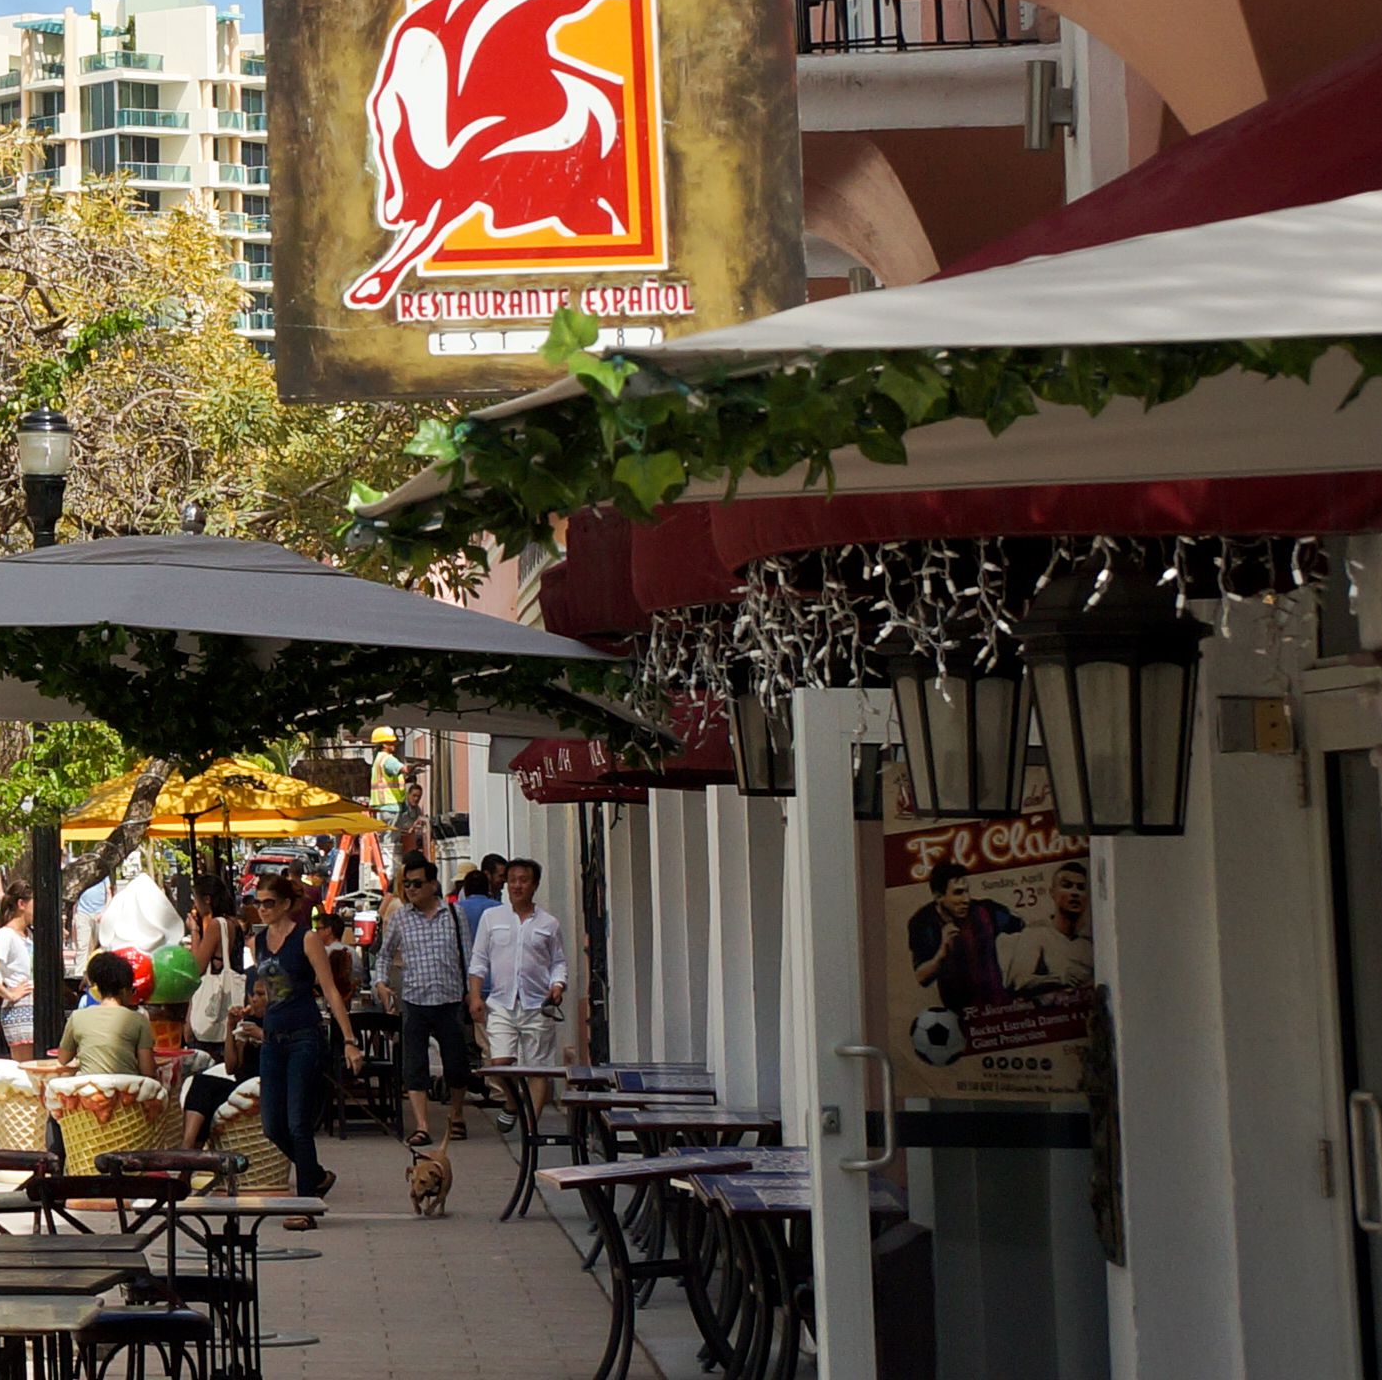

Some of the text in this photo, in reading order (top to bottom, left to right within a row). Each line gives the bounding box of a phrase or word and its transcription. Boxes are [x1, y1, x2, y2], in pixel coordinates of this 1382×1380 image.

[398, 277, 695, 319] RESTAURANTE ESPAÑOL
[1021, 874, 1044, 886] April
